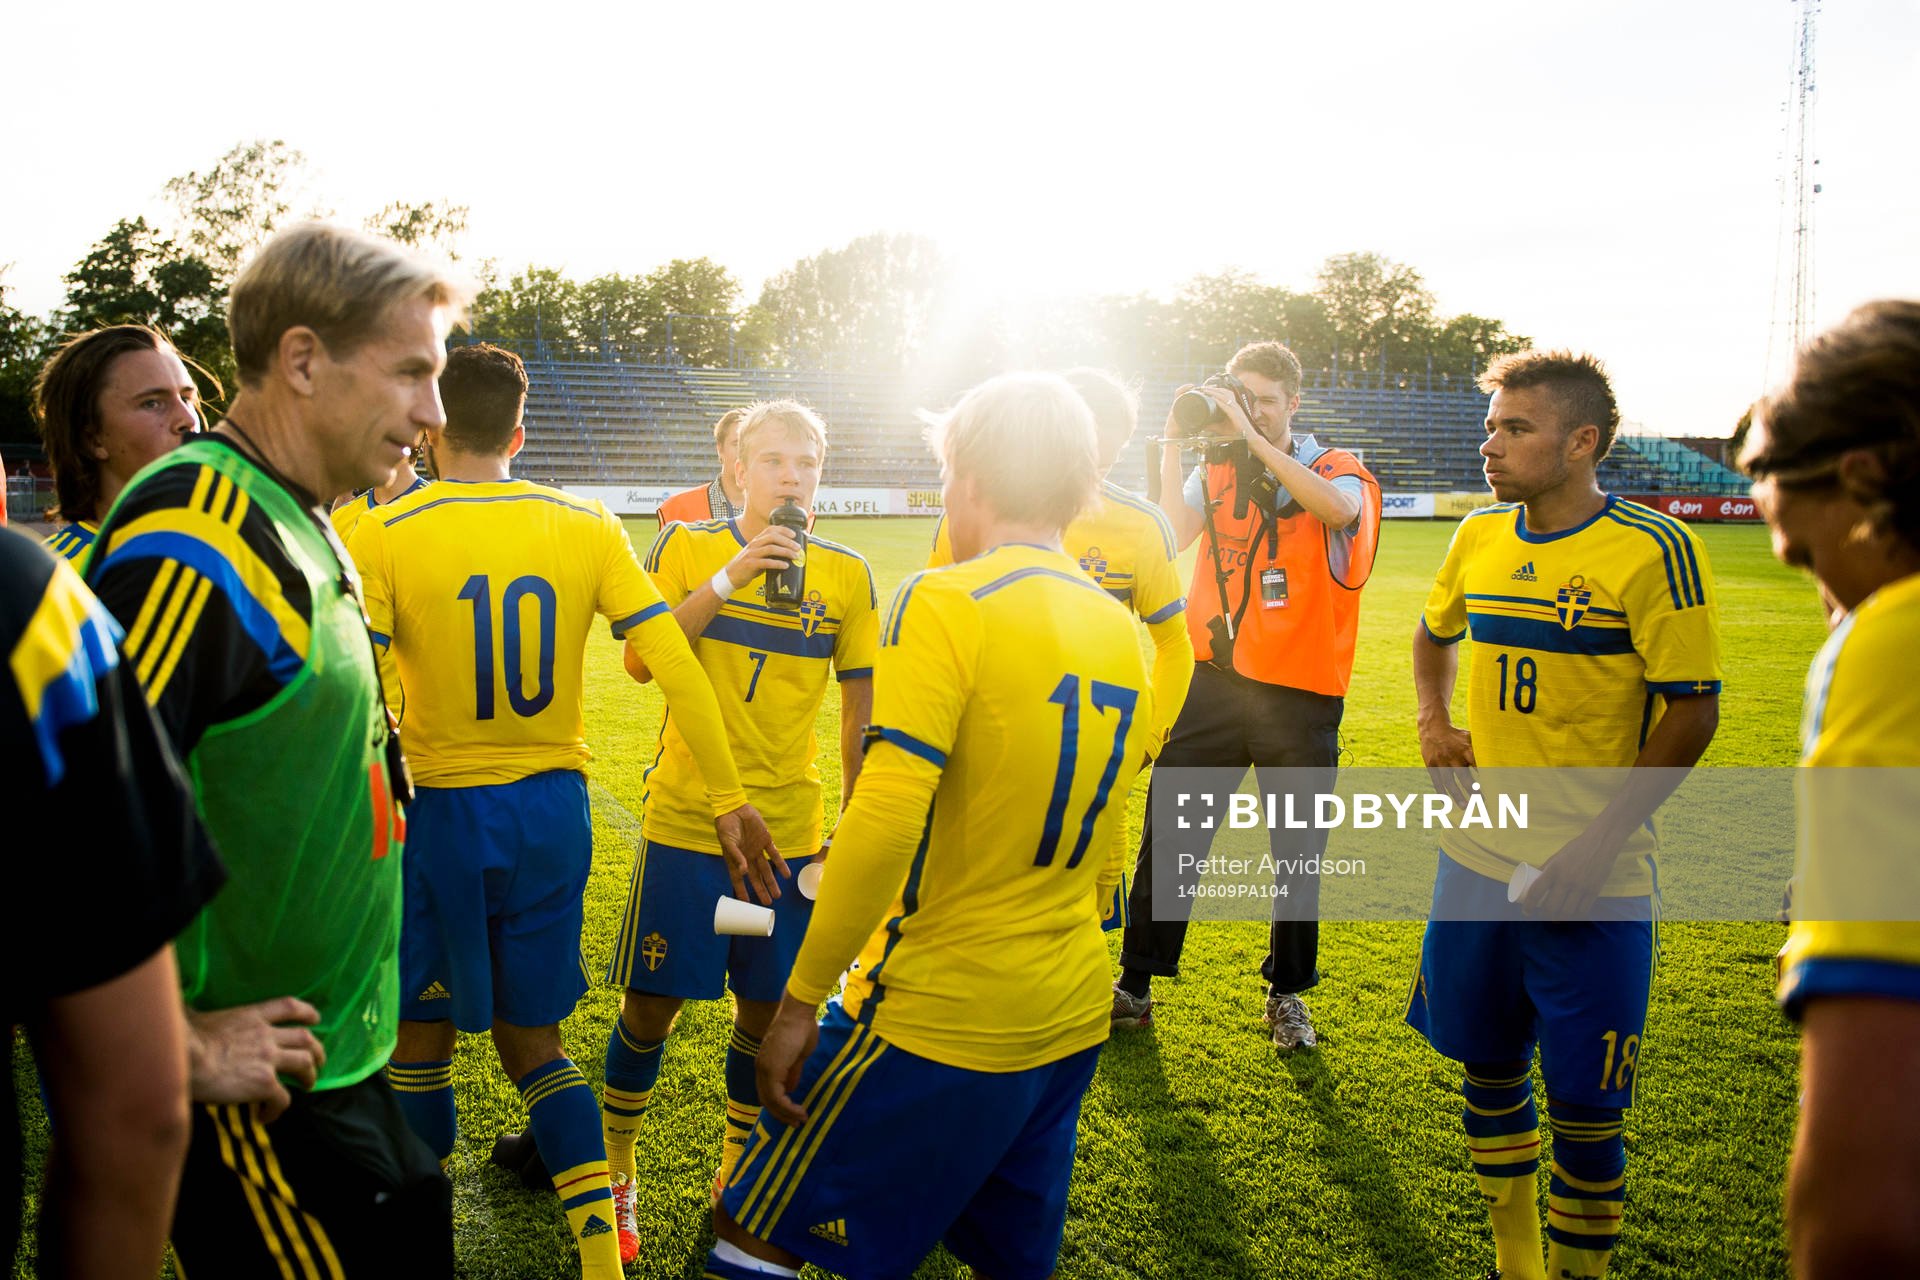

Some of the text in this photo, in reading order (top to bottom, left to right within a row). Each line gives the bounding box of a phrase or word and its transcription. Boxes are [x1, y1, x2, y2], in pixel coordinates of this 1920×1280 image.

[845, 501, 879, 512] SPEL
[1511, 573, 1537, 582] adidas
[456, 574, 557, 720] 10
[744, 651, 768, 702] 7
[1496, 653, 1537, 714] 18
[1033, 673, 1139, 869] 17
[418, 991, 451, 1001] adidas
[1600, 1030, 1640, 1090] 18
[808, 1226, 849, 1247] adidas
